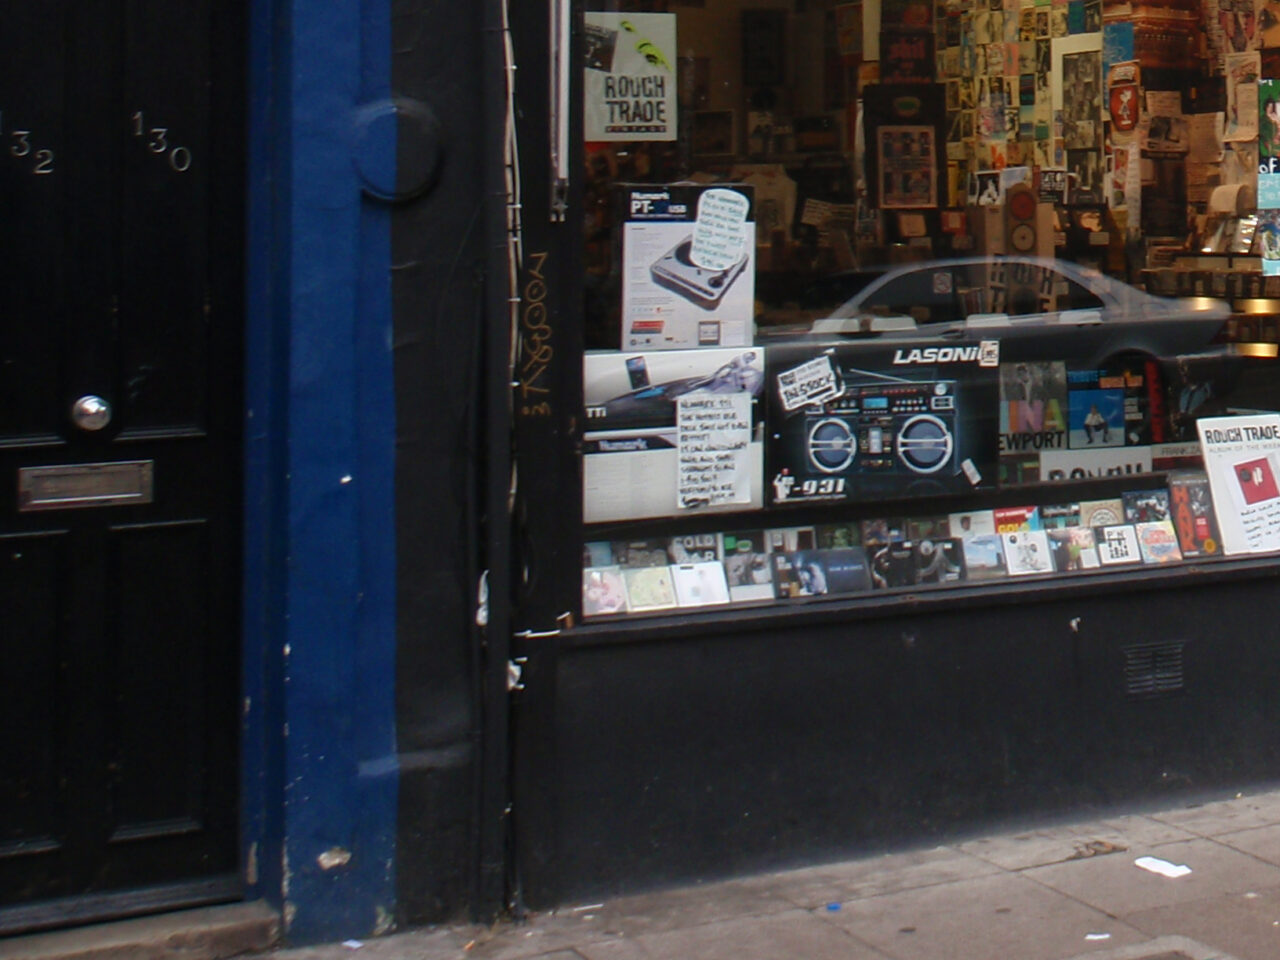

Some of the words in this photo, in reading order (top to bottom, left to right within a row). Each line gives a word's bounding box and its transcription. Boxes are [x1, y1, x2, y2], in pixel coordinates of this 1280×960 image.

[605, 75, 665, 98] ROUGH
[605, 100, 666, 123] TRADE
[132, 111, 191, 172] 130
[998, 431, 1065, 451] EWPORT
[1204, 428, 1242, 444] ROUGH
[1243, 425, 1280, 441] TRADE
